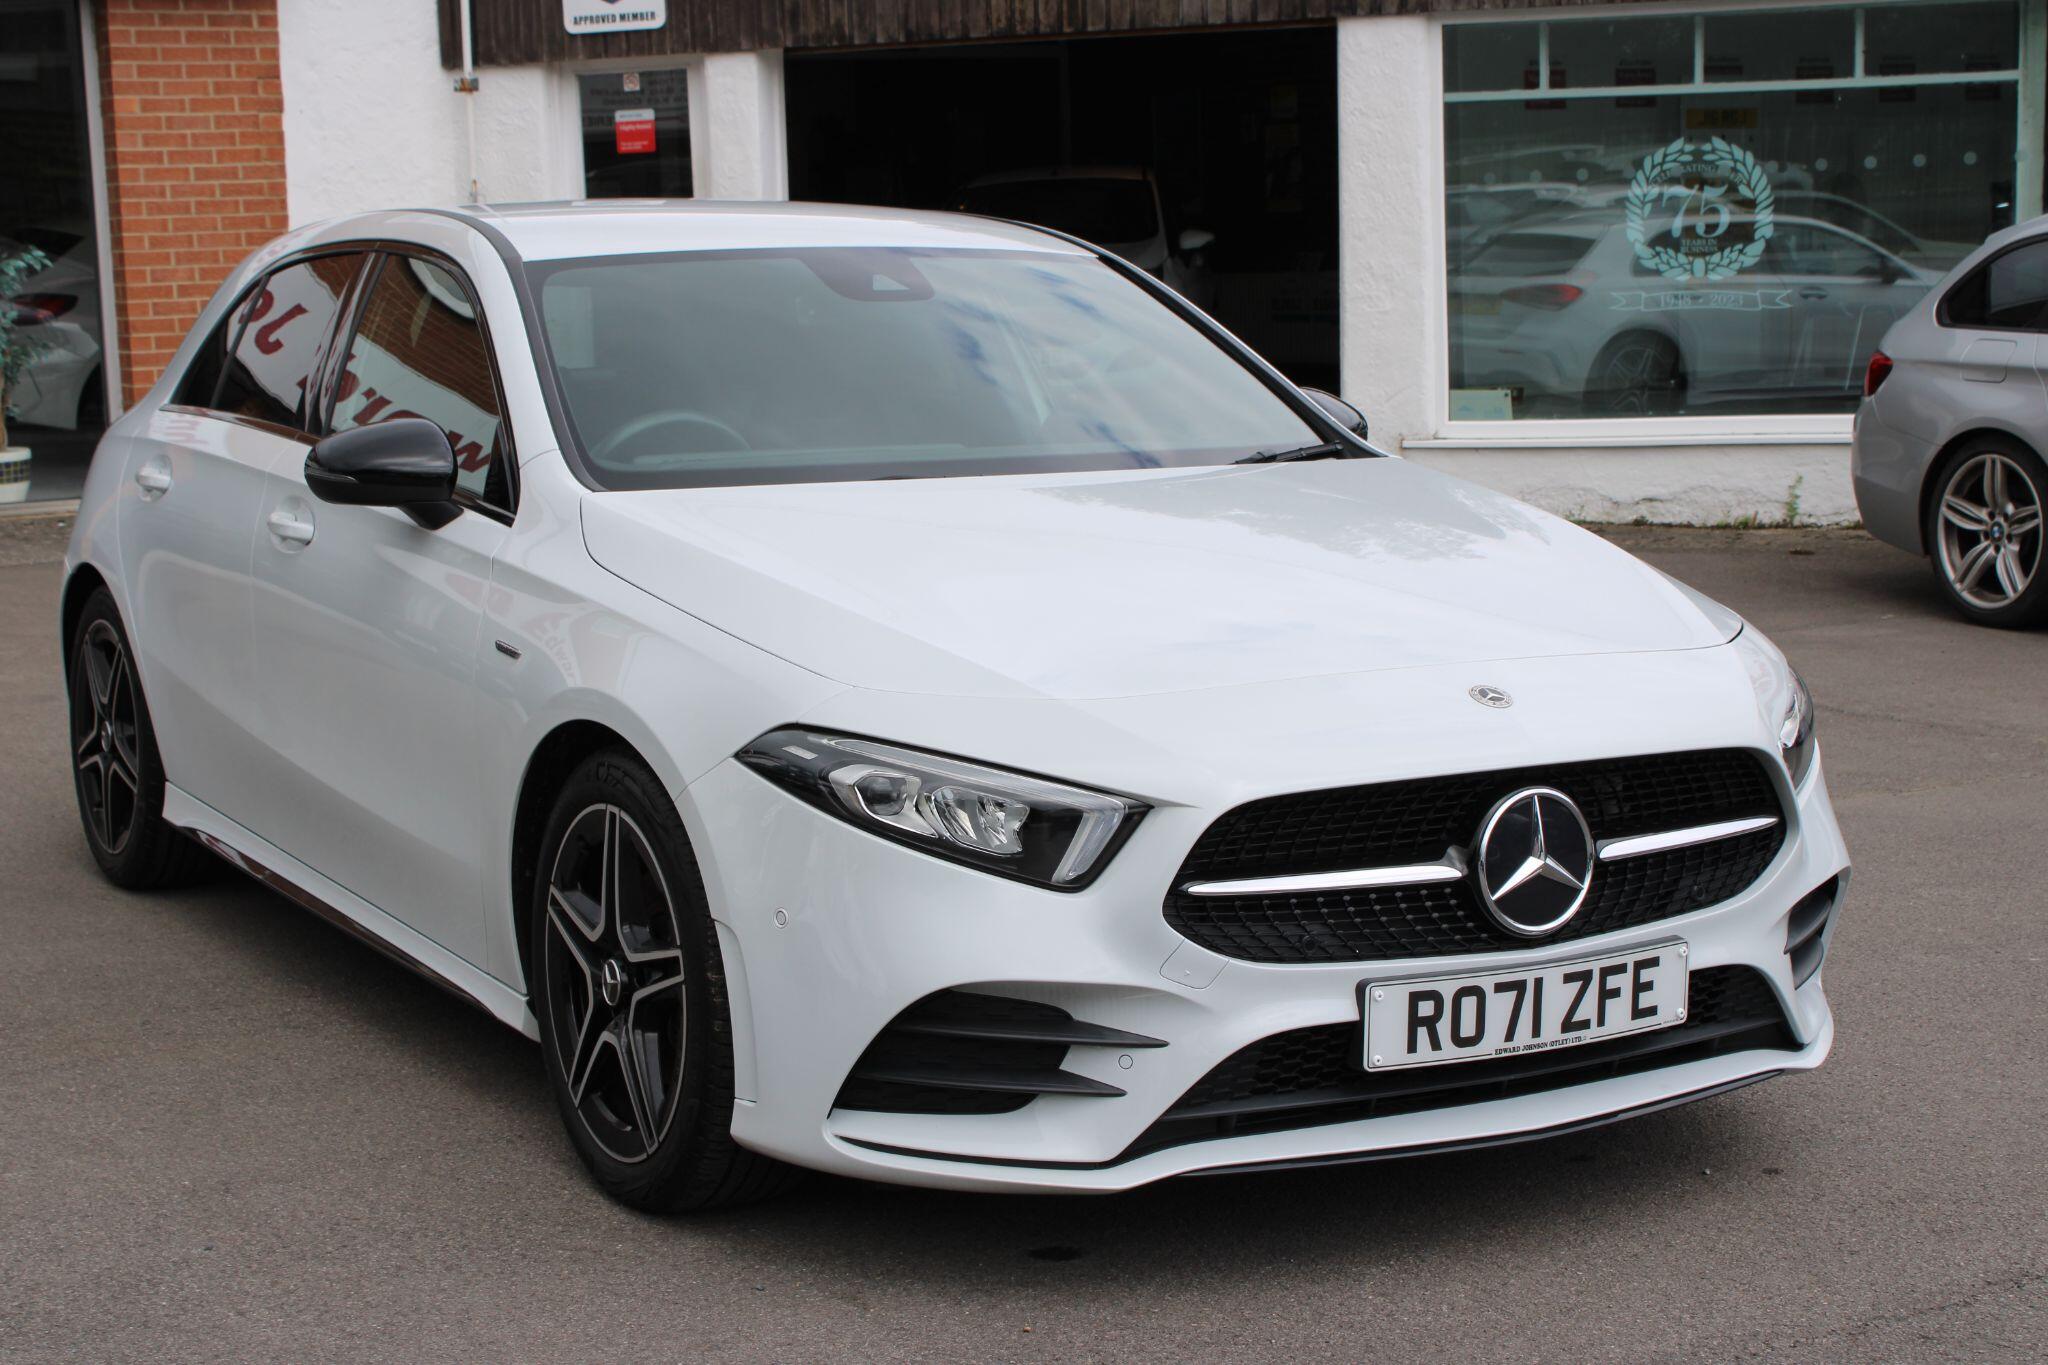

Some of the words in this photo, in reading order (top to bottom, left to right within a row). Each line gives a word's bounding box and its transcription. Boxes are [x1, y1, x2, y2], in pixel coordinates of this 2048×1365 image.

[573, 14, 617, 26] APPROVED
[619, 11, 656, 23] MEMBER
[1661, 183, 1731, 238] 75
[1711, 293, 1744, 307] 2023
[1407, 976, 1544, 1055] RO71
[1560, 955, 1661, 1034] ZFE
[1494, 1045, 1521, 1055] EDWARD
[1521, 1041, 1548, 1052] JOHNSON
[1549, 1037, 1571, 1047] (OTLEY)
